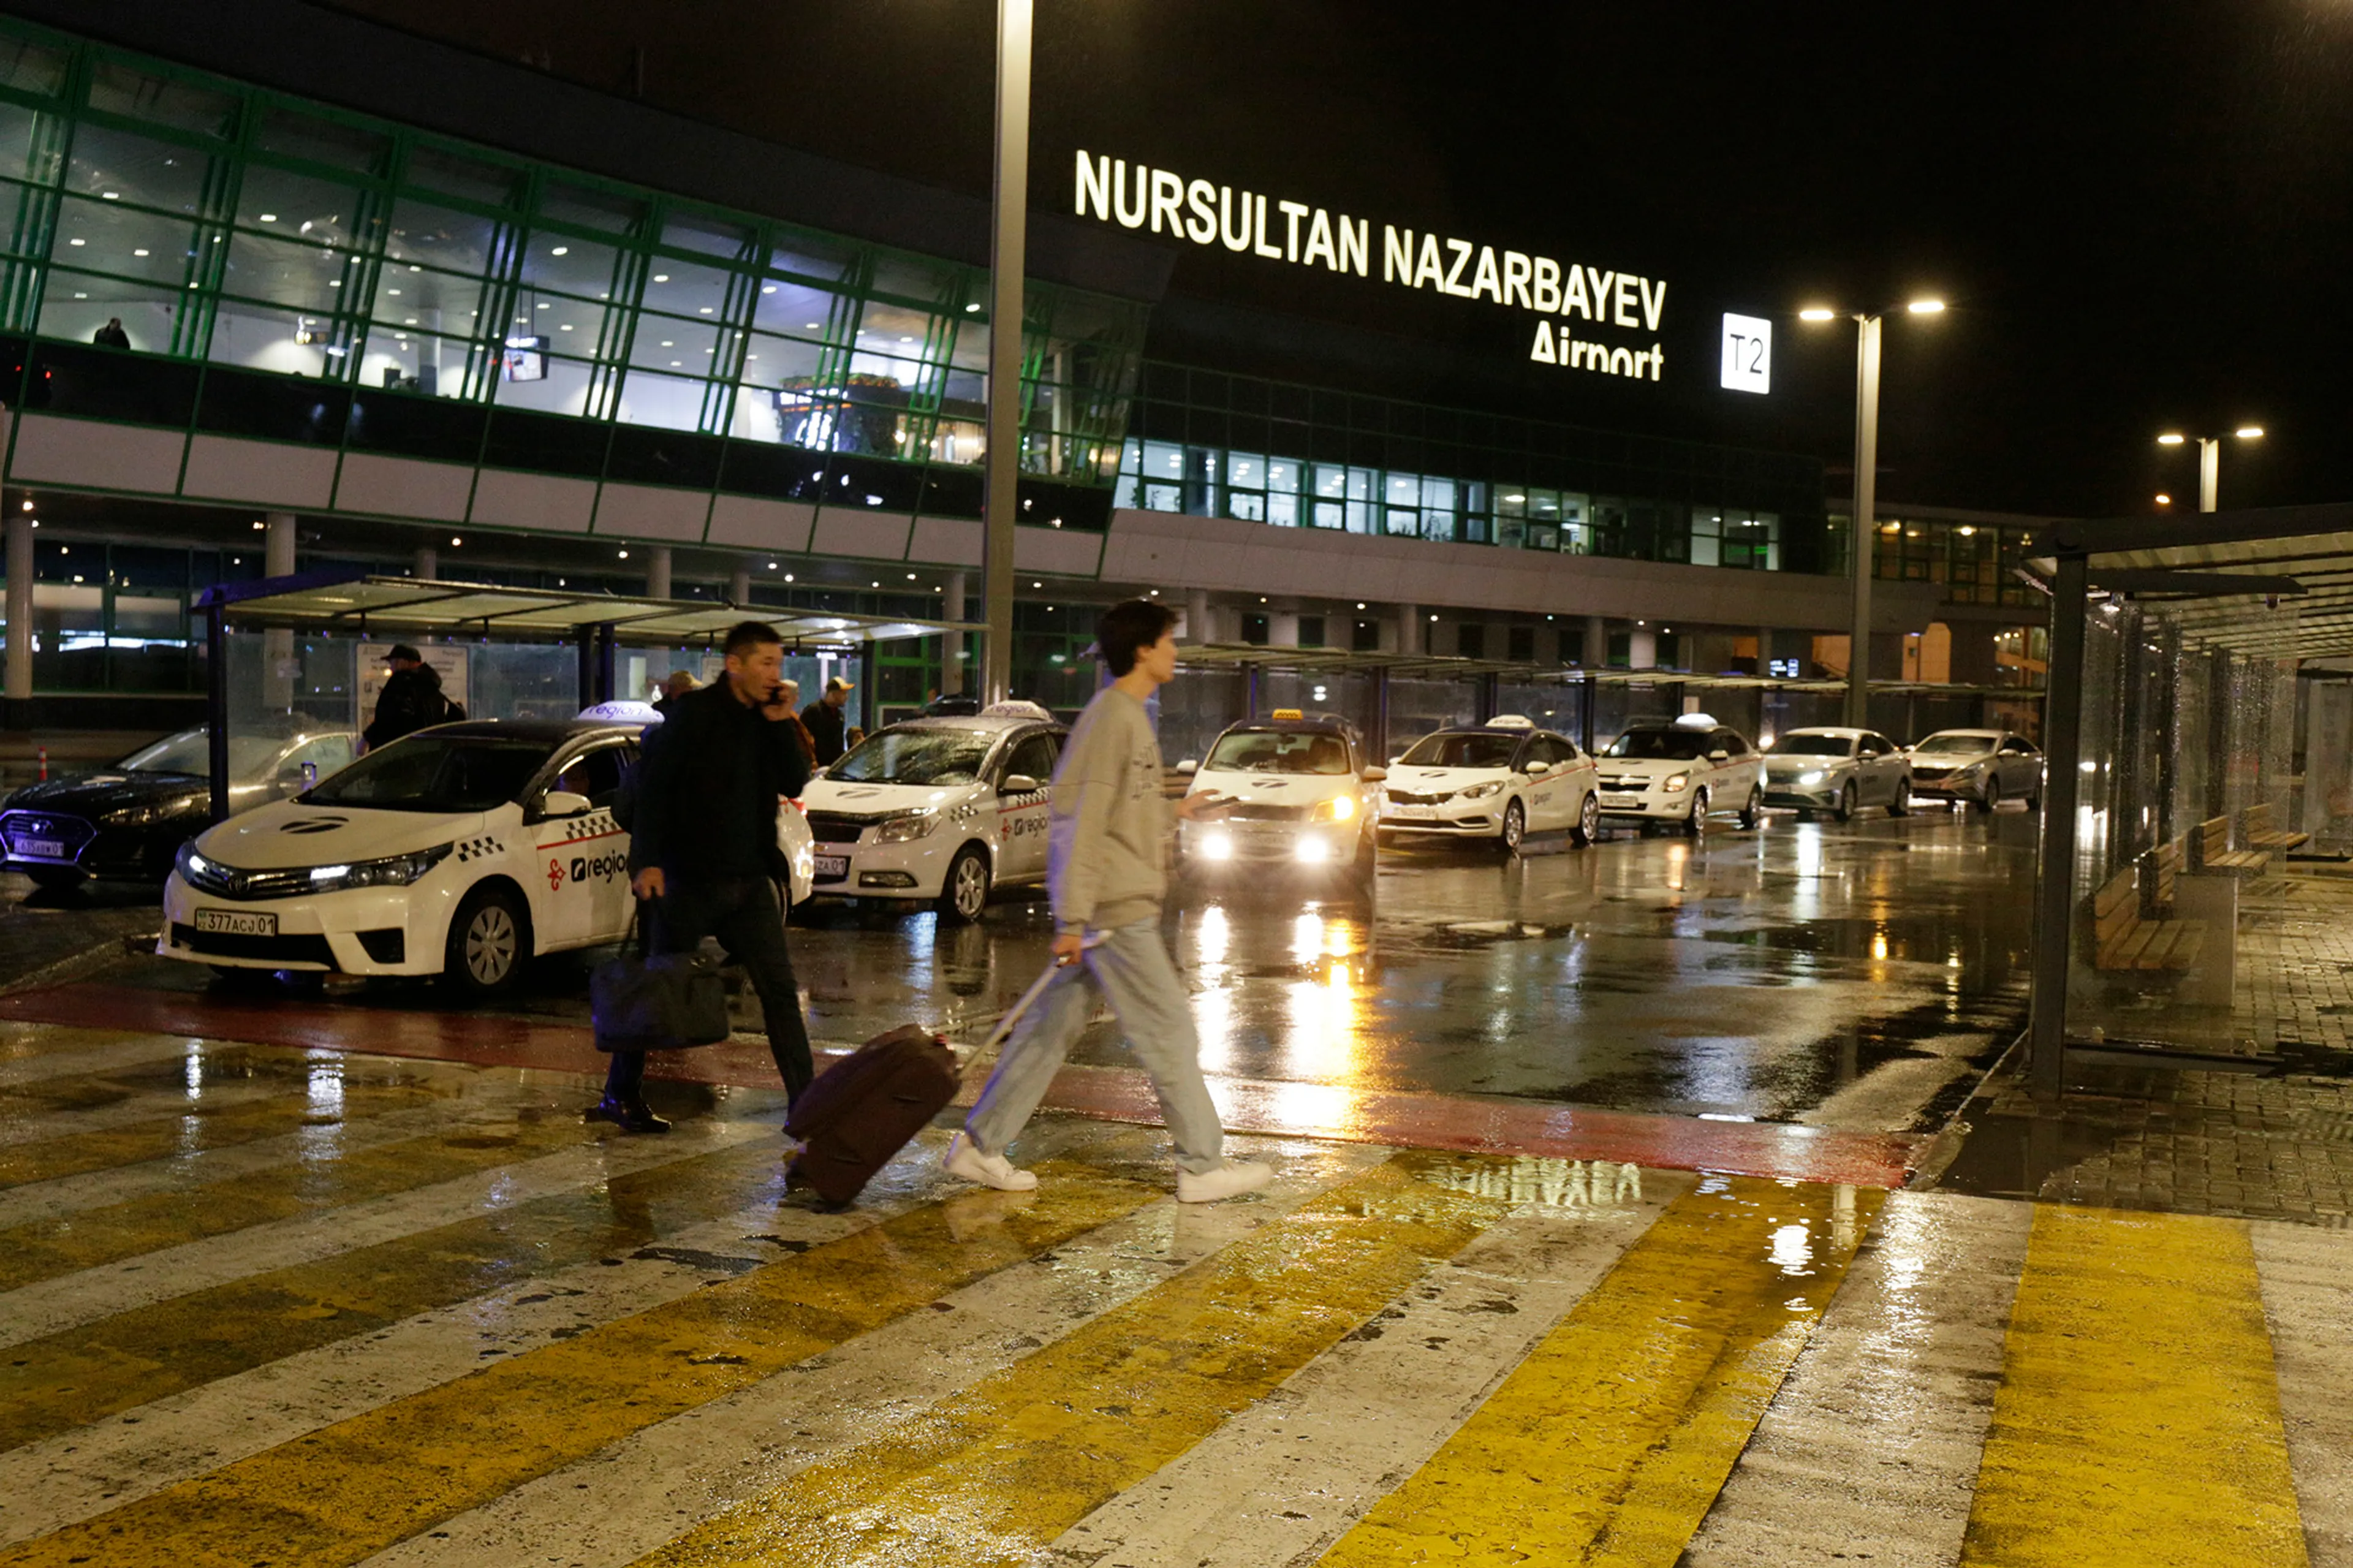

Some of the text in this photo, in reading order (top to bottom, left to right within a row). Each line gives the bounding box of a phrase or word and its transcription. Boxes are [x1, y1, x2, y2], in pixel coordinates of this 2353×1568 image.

[1075, 150, 1667, 331] NURSULTAN NAZARBAYEV
[589, 705, 642, 719] region
